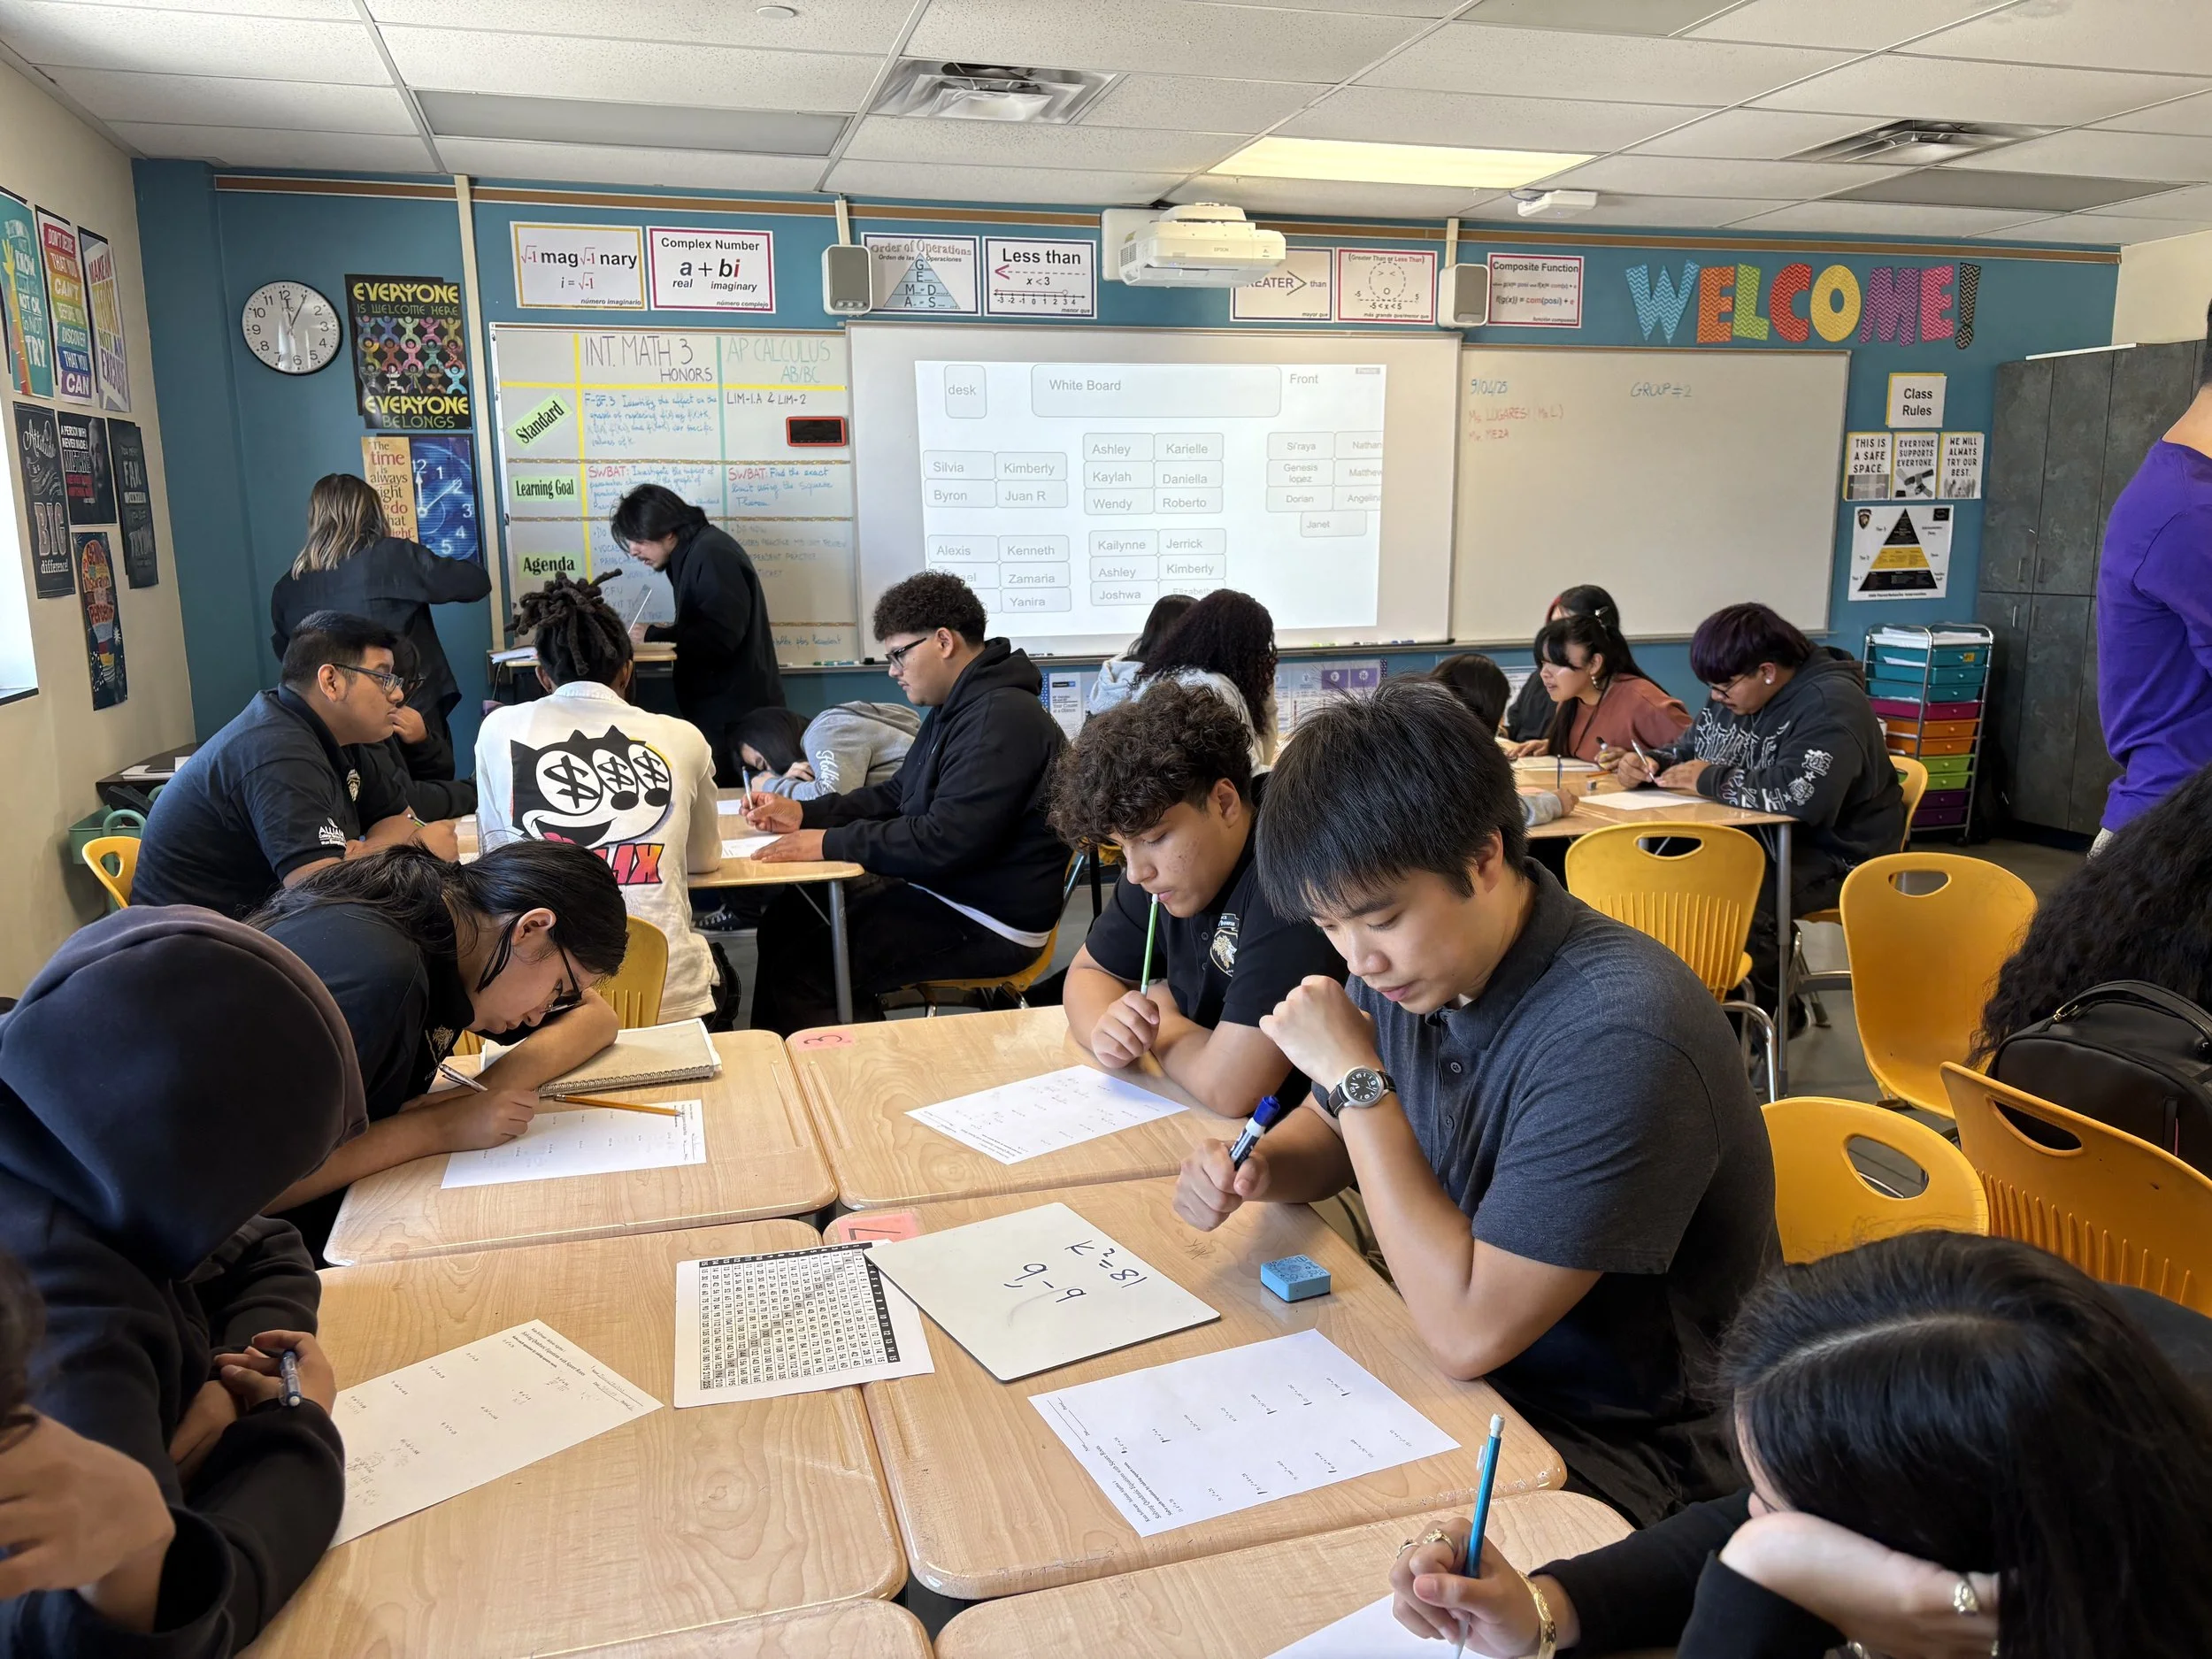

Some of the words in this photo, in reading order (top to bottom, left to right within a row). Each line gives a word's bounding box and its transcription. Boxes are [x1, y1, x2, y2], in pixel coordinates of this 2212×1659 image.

[661, 237, 712, 250] Complex
[715, 239, 760, 251] Number
[871, 243, 902, 254] Order
[903, 242, 915, 253] of
[916, 240, 972, 257] Operations
[1002, 248, 1041, 264] Less
[1045, 250, 1082, 265] than
[680, 260, 693, 277] a
[718, 258, 741, 279] bi
[915, 258, 925, 272] G
[1492, 261, 1540, 273] Composite
[1541, 262, 1579, 273] Function
[916, 271, 924, 283] E
[1310, 280, 1327, 288] than
[55, 279, 79, 301] CAN'T
[672, 278, 693, 289] real
[710, 280, 757, 293] imaginary
[279, 290, 291, 302] 12
[353, 282, 460, 304] EVERYONE
[264, 296, 273, 305] 11
[1625, 259, 1982, 349] WELCOME!
[252, 307, 266, 319] 10
[314, 305, 323, 316] 2
[357, 304, 366, 314] IS
[372, 303, 426, 316] WELCOME
[430, 305, 458, 316] HERE
[252, 324, 261, 335] 9
[320, 321, 329, 332] 3
[260, 341, 270, 351] 8
[319, 338, 327, 348] 4
[25, 334, 47, 368] TRY
[309, 350, 319, 361] 5
[584, 335, 616, 367] INT.
[621, 334, 672, 367] MATH
[680, 338, 694, 366] 3
[727, 337, 751, 363] AP
[753, 337, 832, 364] CALCULUS
[293, 355, 302, 365] 6
[660, 367, 713, 383] HONORS
[780, 365, 820, 384] AB/BC
[65, 373, 88, 395] CAN
[1049, 379, 1083, 391] White
[1087, 380, 1121, 391] Board
[1289, 373, 1318, 384] Front
[948, 384, 976, 396] desk
[1903, 388, 1933, 399] Class
[365, 396, 469, 415] EVERYONE
[1902, 404, 1932, 417] Rules
[382, 416, 456, 429] BELONGS
[515, 399, 565, 446] Standard
[373, 441, 389, 450] The
[1855, 439, 1875, 448] THIS
[1877, 439, 1886, 448] IS
[1949, 437, 1961, 446] WE
[1962, 437, 1977, 446] WILL
[1092, 444, 1131, 457] Ashley
[1166, 443, 1209, 454] Karielle
[1854, 451, 1861, 460] A
[1863, 451, 1886, 460] SAFE
[371, 452, 405, 466] time
[380, 465, 388, 474] is
[411, 459, 427, 474] 12
[436, 465, 444, 480] 1
[588, 465, 629, 478] SWBAT:
[933, 461, 964, 473] Silvia
[1003, 463, 1056, 475] Kimberly
[1092, 472, 1132, 484] Kaylah
[1162, 473, 1208, 484] Daniella
[1283, 464, 1318, 472] Genesis
[1853, 464, 1885, 473] SPACE.
[1951, 468, 1971, 477] BEST.
[370, 472, 408, 484] always
[728, 467, 767, 481] SWBAT:
[516, 479, 554, 499] Learning
[555, 479, 574, 495] Goal
[390, 500, 408, 514] do
[933, 490, 968, 503] Byron
[1004, 491, 1033, 502] Juan
[1036, 491, 1047, 501] R
[1093, 498, 1133, 511] Wendy
[1162, 498, 1207, 509] Roberto
[1286, 495, 1314, 503] Dorian
[462, 503, 472, 518] 3
[34, 502, 66, 557] BIG
[1307, 520, 1330, 529] Janet
[456, 525, 465, 539] 4
[442, 538, 453, 555] 5
[936, 546, 971, 557] Alexis
[1007, 545, 1056, 556] Kenneth
[1097, 540, 1146, 552] Kailynne
[1166, 539, 1202, 549] Jerrick
[523, 556, 575, 573] Agenda
[1008, 573, 1056, 584] Zamaria
[1098, 567, 1136, 579] Ashley
[1166, 564, 1214, 576] Kimberly
[1010, 597, 1046, 607] Yanira
[1099, 590, 1141, 600] Joshwa
[1094, 1443, 1107, 1456] Roots
[1102, 1453, 1116, 1467] Square
[1118, 1471, 1136, 1491] Equations
[1132, 1487, 1150, 1507] Quadratic
[1146, 1503, 1162, 1521] Solving
